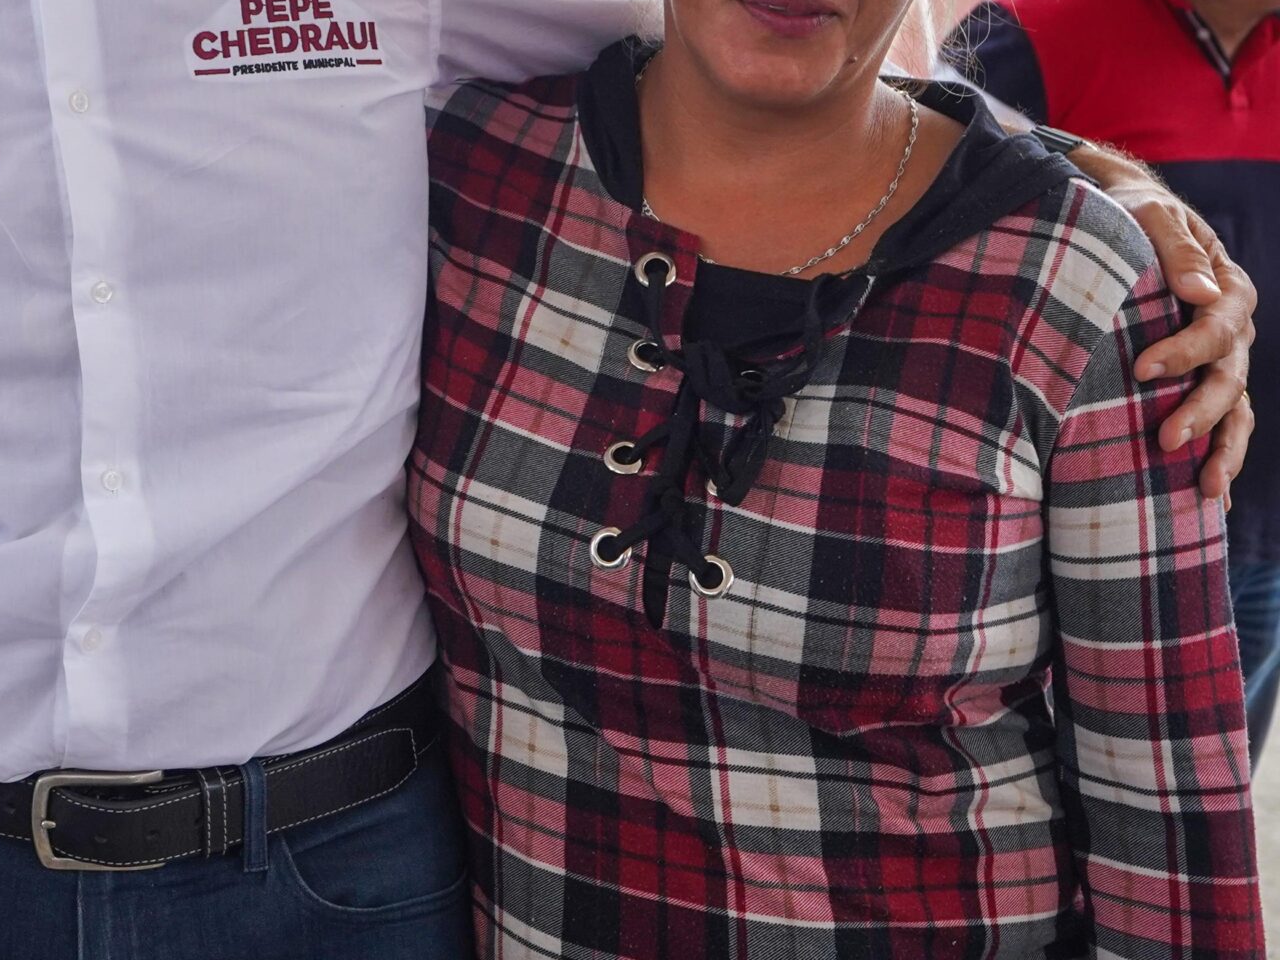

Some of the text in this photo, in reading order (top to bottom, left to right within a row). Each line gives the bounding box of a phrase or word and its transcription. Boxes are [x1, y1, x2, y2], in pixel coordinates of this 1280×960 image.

[192, 21, 378, 60] CHEDRAUI
[232, 57, 356, 76] PRESIDENTE MUNICIPAL
